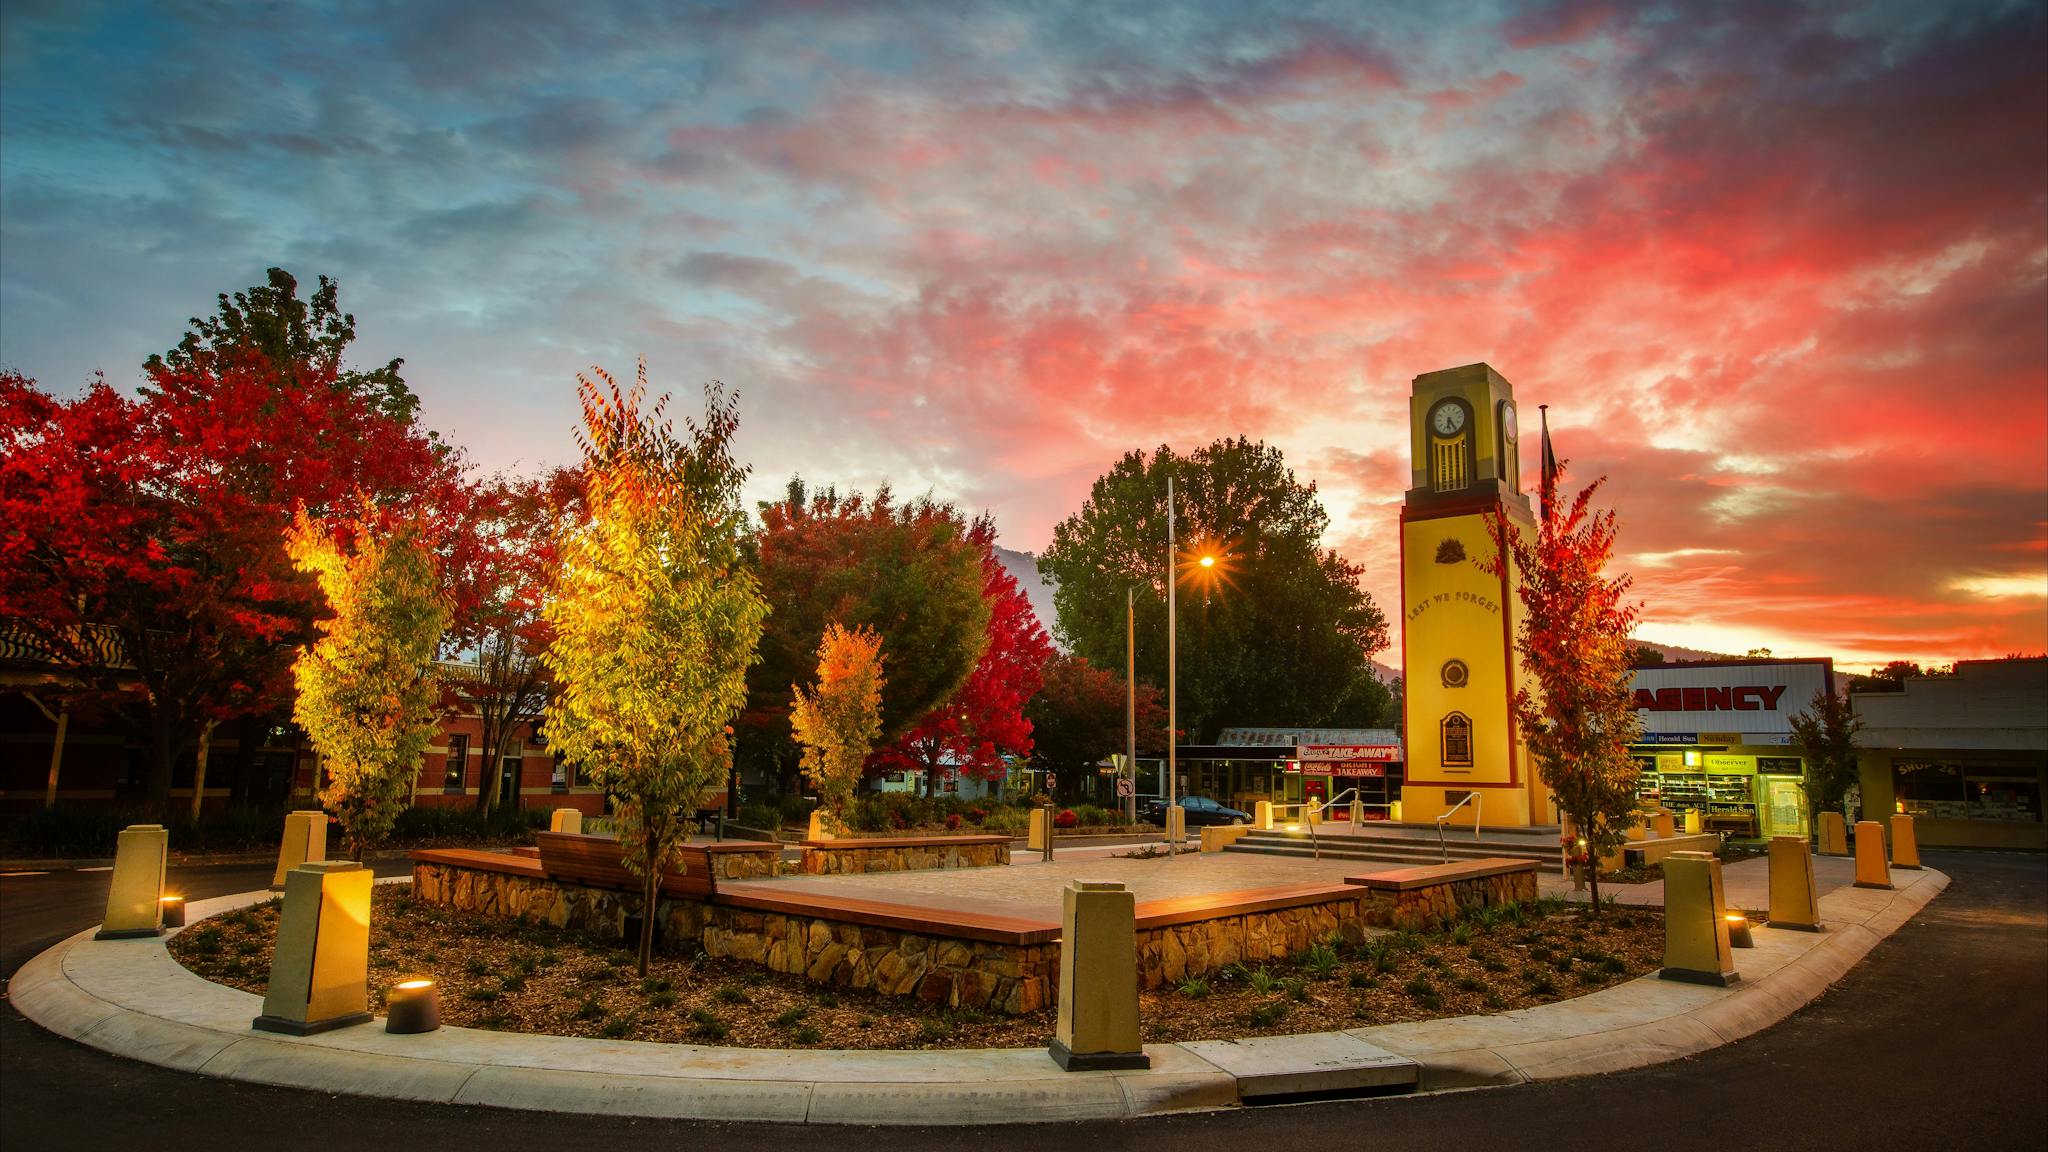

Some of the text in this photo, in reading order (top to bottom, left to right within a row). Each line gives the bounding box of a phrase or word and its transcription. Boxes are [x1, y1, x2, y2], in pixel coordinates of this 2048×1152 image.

[1408, 592, 1500, 620] LEST WE FORGET
[1631, 685, 1787, 711] AGENCY
[1703, 735, 1736, 744] Sunday
[1329, 748, 1387, 758] TAKE-AWAY
[1337, 768, 1377, 776] TAKEAWAY
[1898, 763, 1932, 774] SHOP
[1711, 804, 1755, 814] Herald Sun
